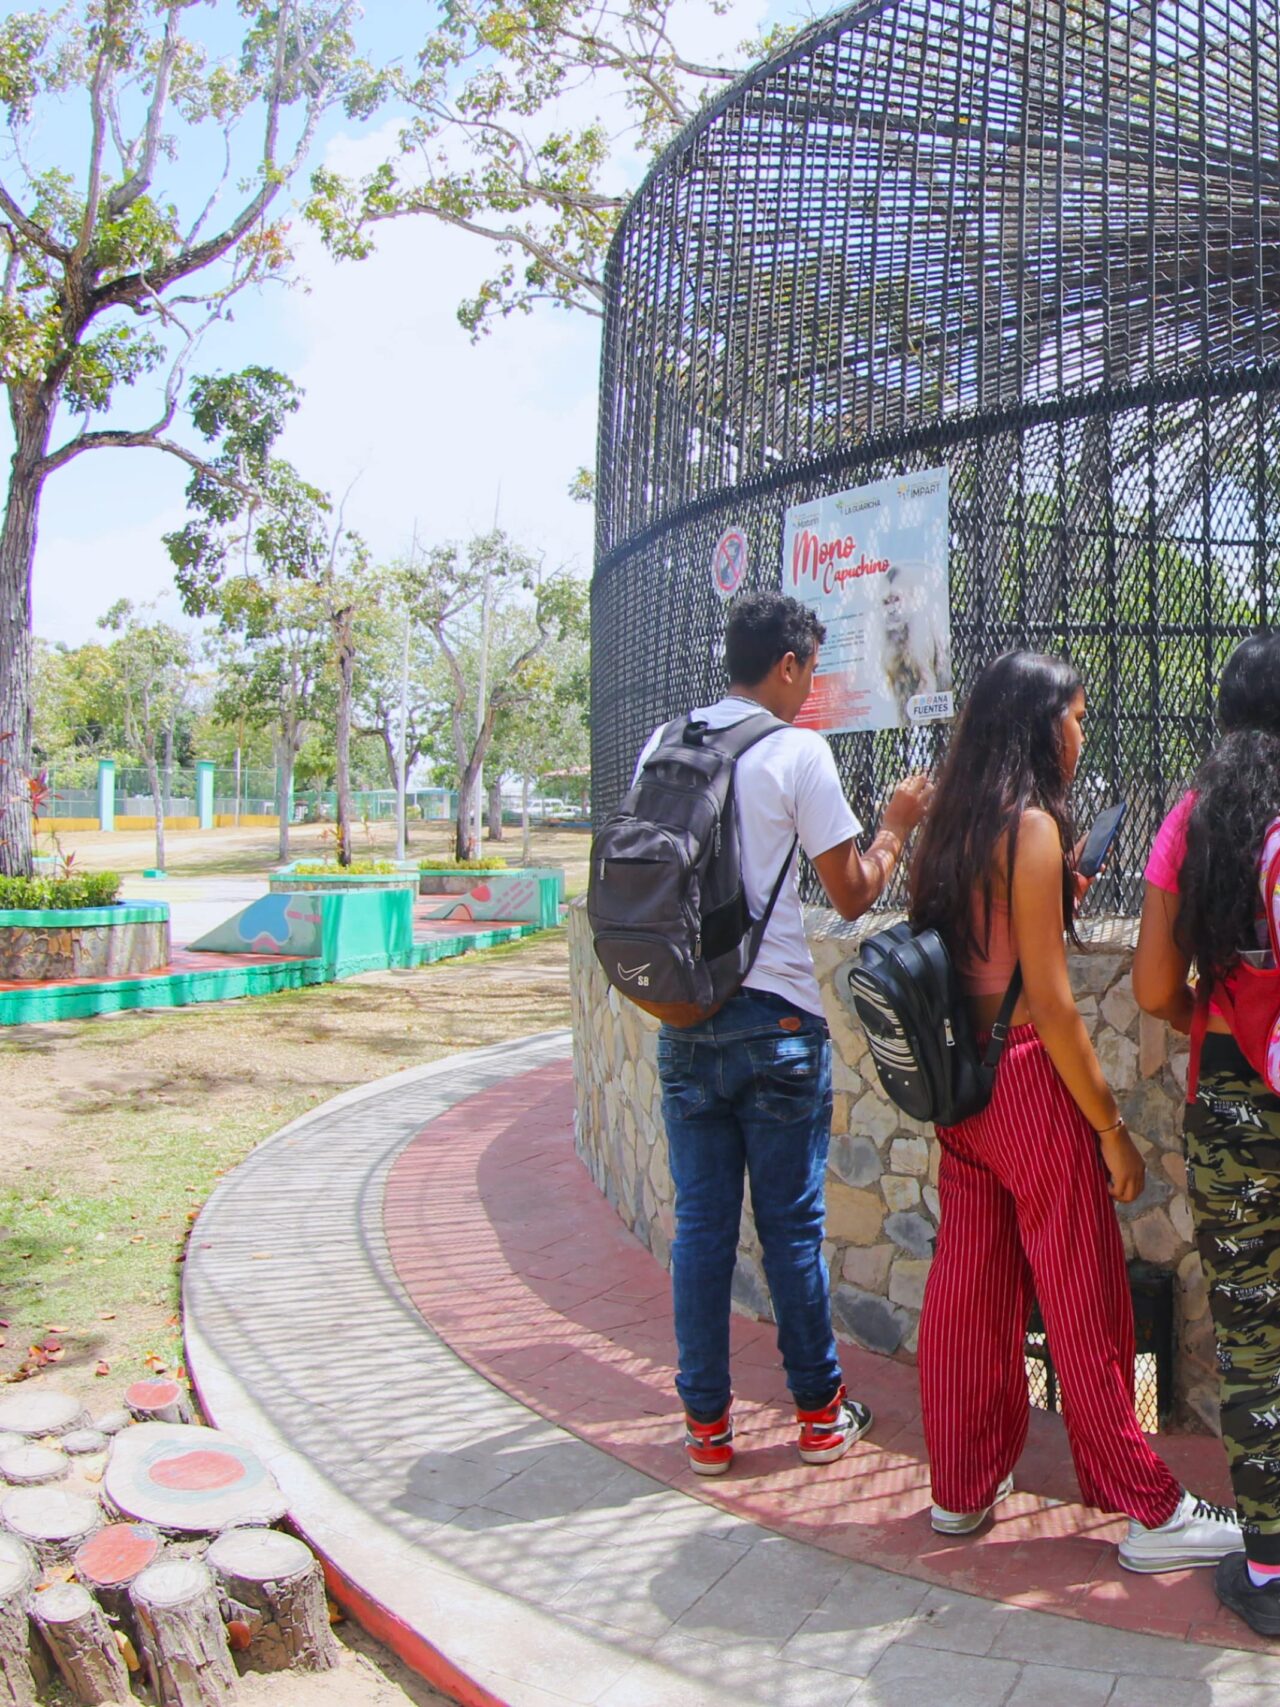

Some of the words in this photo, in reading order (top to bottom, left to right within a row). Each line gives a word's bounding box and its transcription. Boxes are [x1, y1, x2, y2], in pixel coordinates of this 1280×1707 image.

[911, 483, 941, 498] IMPART
[793, 530, 856, 586] Mono
[823, 554, 890, 594] Capuchino
[933, 695, 948, 704] ANA
[914, 703, 948, 715] FUENTES
[637, 975, 650, 987] SB
